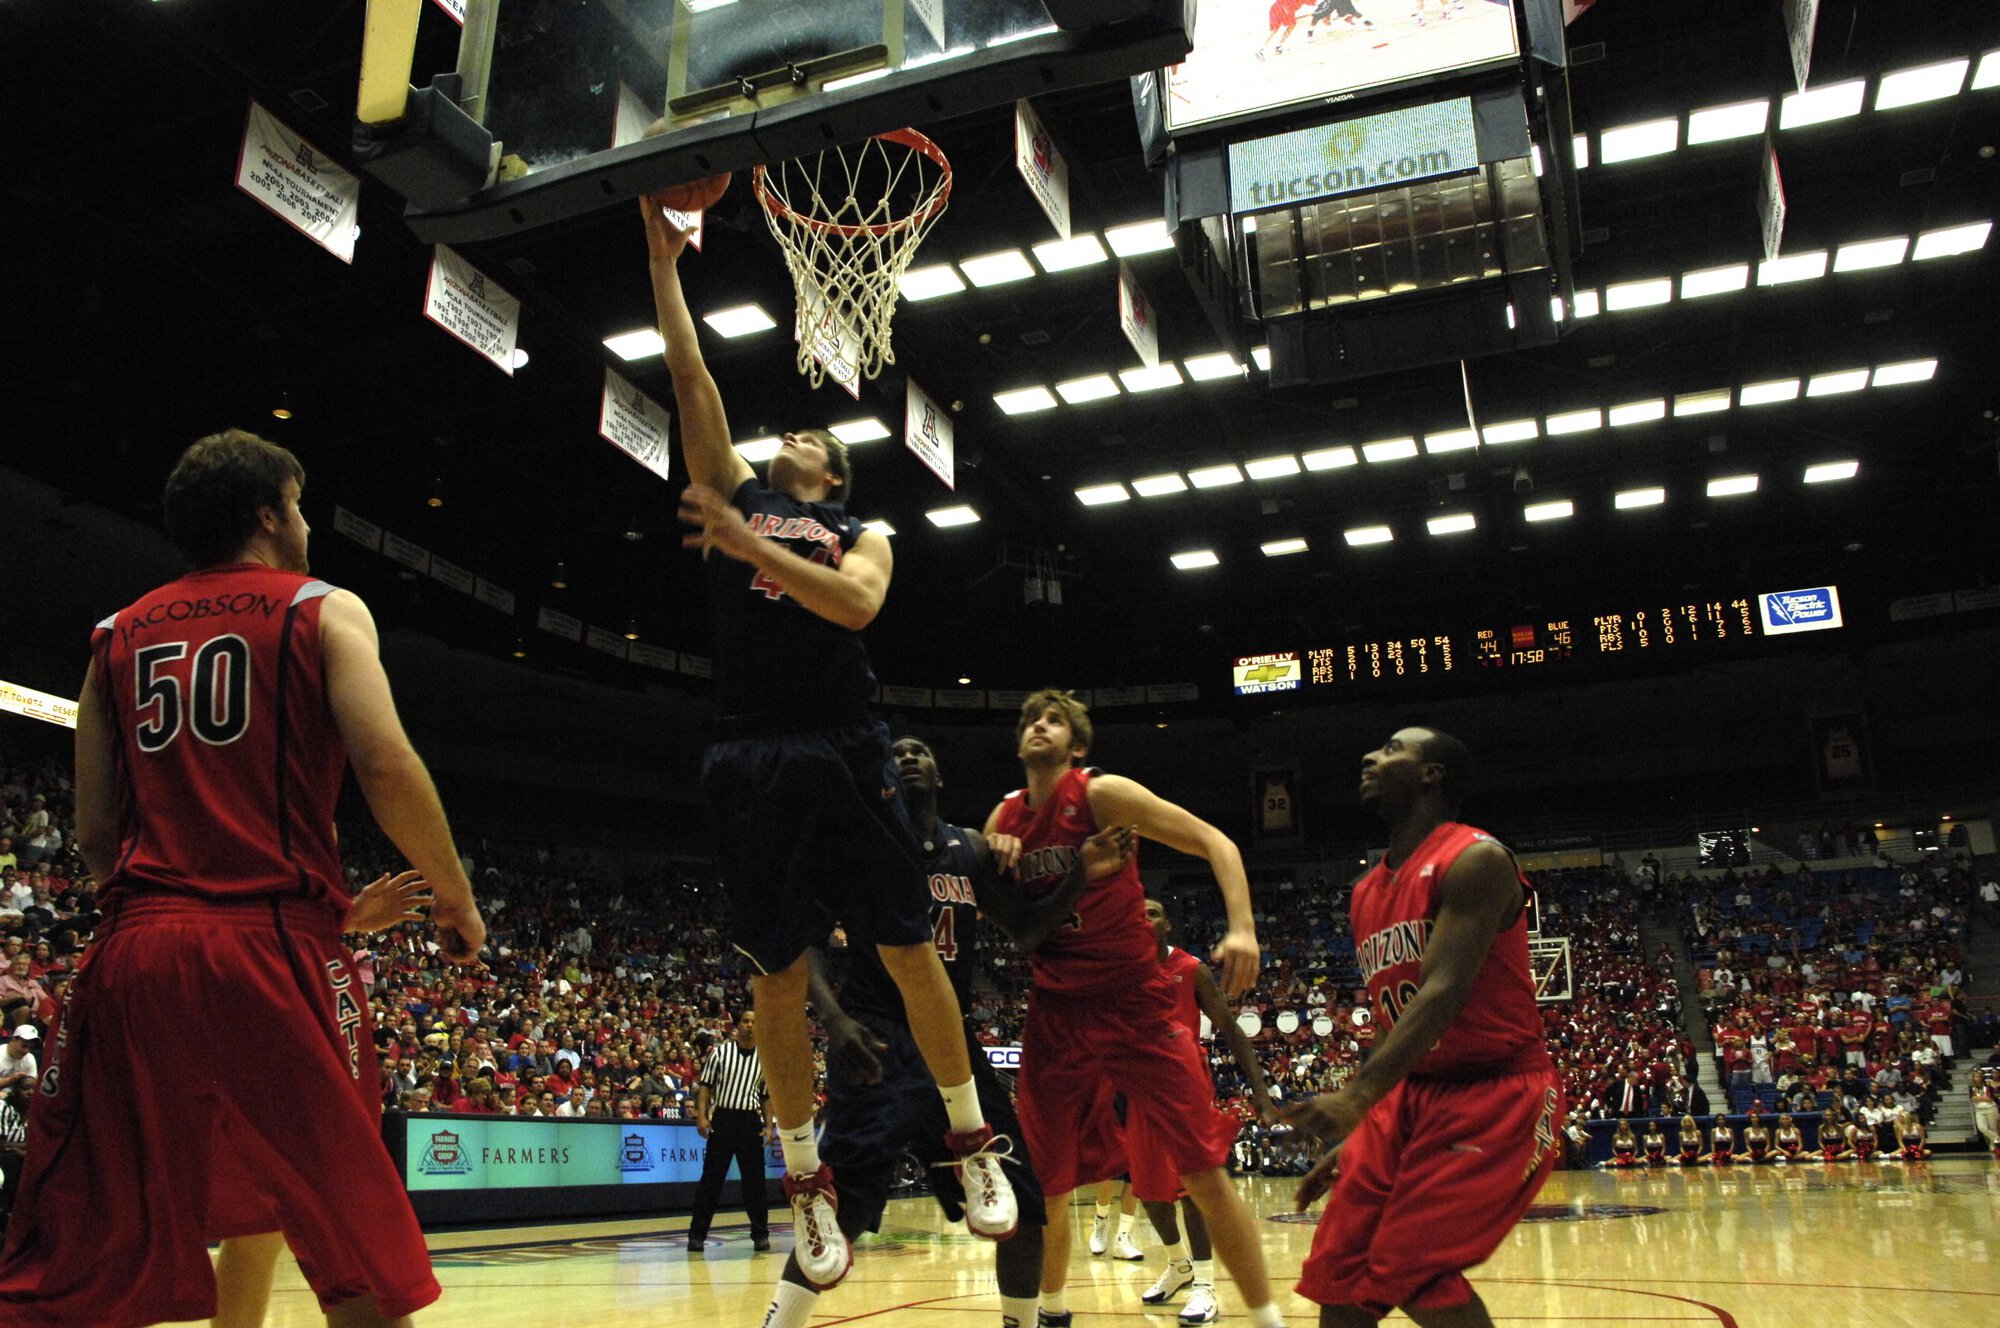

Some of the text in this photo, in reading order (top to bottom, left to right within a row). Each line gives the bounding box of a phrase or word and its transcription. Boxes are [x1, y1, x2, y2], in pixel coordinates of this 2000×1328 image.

[1326, 93, 1354, 104] VIACOM
[1249, 150, 1451, 204] tucson.com
[262, 159, 340, 216] NCAA TOURNAMENT
[922, 403, 939, 449] A
[1781, 594, 1818, 605] Tucson
[1787, 600, 1826, 612] Electric
[1594, 615, 1621, 626] PLYR
[1637, 611, 1645, 620] 0
[1662, 608, 1670, 617] 2
[1732, 599, 1748, 608] 44
[1792, 609, 1827, 620] Power
[120, 593, 281, 648] JACOBSON
[1548, 621, 1569, 631] BLUE
[1477, 630, 1493, 639] RED
[1600, 624, 1619, 633] PTS
[1554, 631, 1571, 644] 46
[1600, 632, 1622, 643] RBS
[1600, 641, 1623, 651] FLS
[1666, 635, 1674, 644] 0
[1308, 649, 1333, 659] PLYR
[1387, 641, 1402, 650] 34
[1411, 638, 1426, 648] 50
[1435, 636, 1450, 645] 54
[1480, 640, 1497, 652] 44
[1239, 652, 1293, 666] O'RIELLY
[1313, 657, 1331, 667] PTS
[1371, 652, 1379, 660] 0
[1419, 647, 1427, 655] 4
[1512, 649, 1544, 665] 17:58
[1312, 665, 1333, 675] RBS
[1372, 660, 1380, 669] 0
[1396, 658, 1403, 666] 0
[1373, 668, 1380, 677] 0
[1396, 666, 1404, 675] 0
[135, 633, 250, 752] 50
[1240, 680, 1296, 694] WATSON
[11, 693, 43, 707] TOYOTA
[1268, 798, 1286, 810] 32
[662, 1108, 682, 1119] POSS.
[482, 1147, 569, 1164] FARMERS
